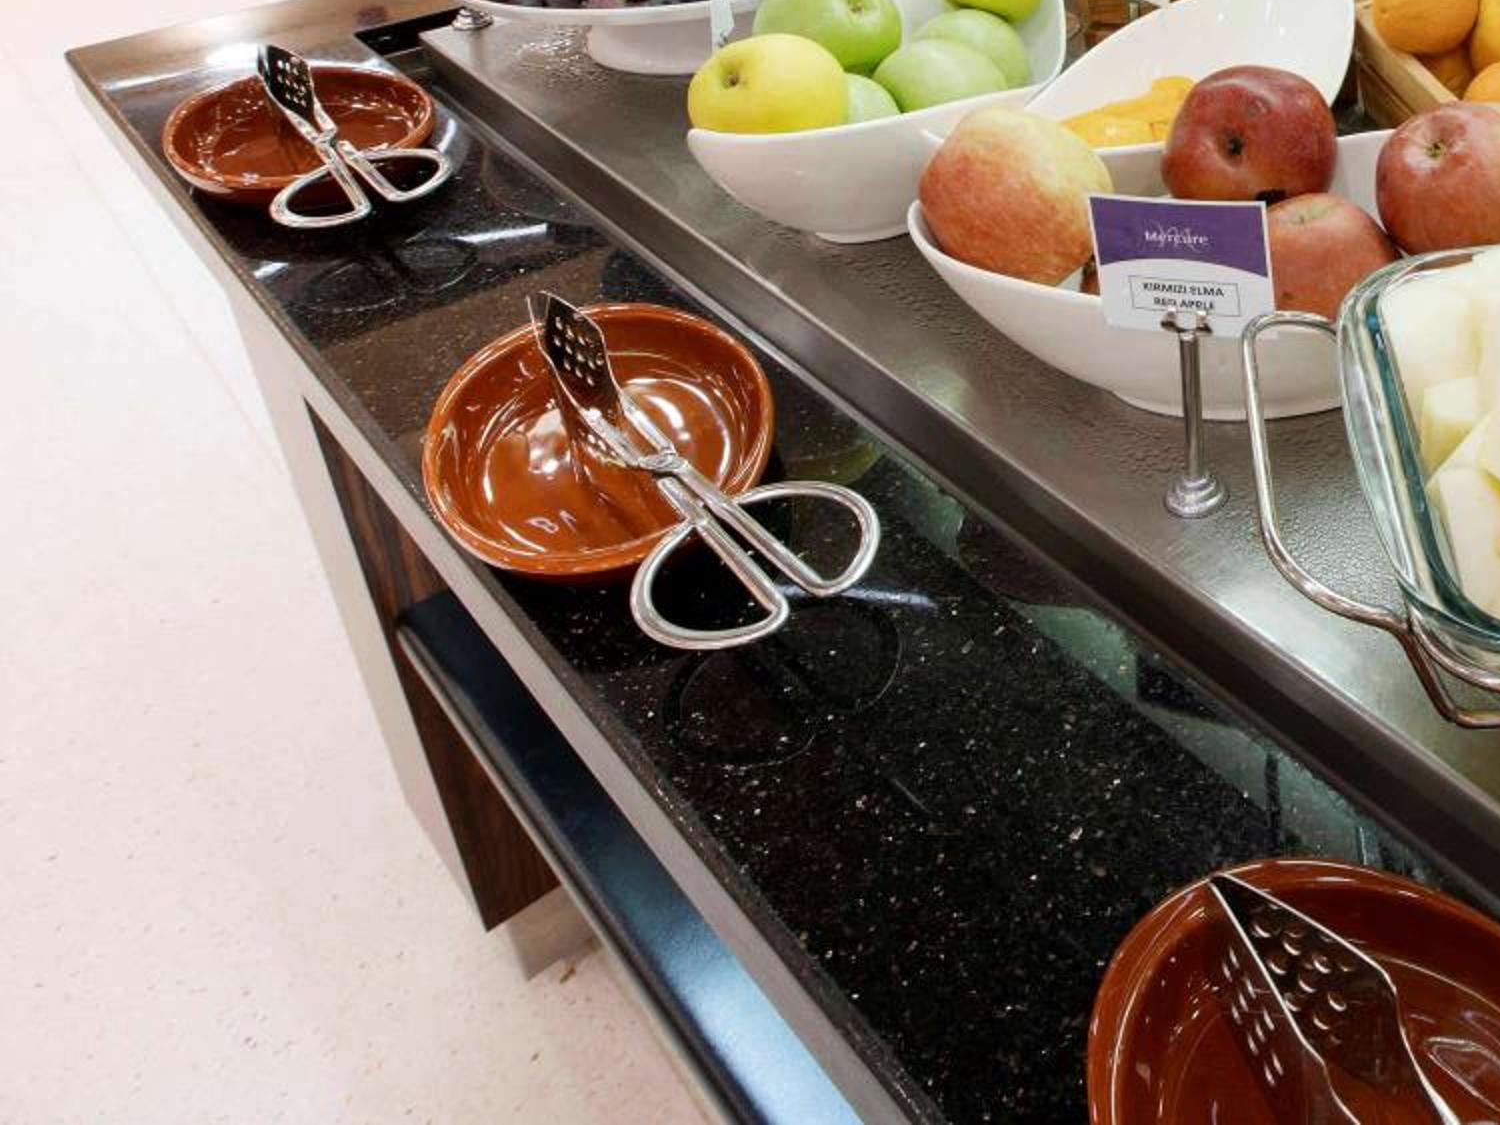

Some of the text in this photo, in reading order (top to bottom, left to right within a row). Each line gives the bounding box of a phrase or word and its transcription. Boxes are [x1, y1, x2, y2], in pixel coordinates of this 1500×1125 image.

[1144, 229, 1209, 247] Mercure
[1143, 282, 1225, 297] KIRMIZI ELMA
[1153, 296, 1215, 311] RED APPLE
